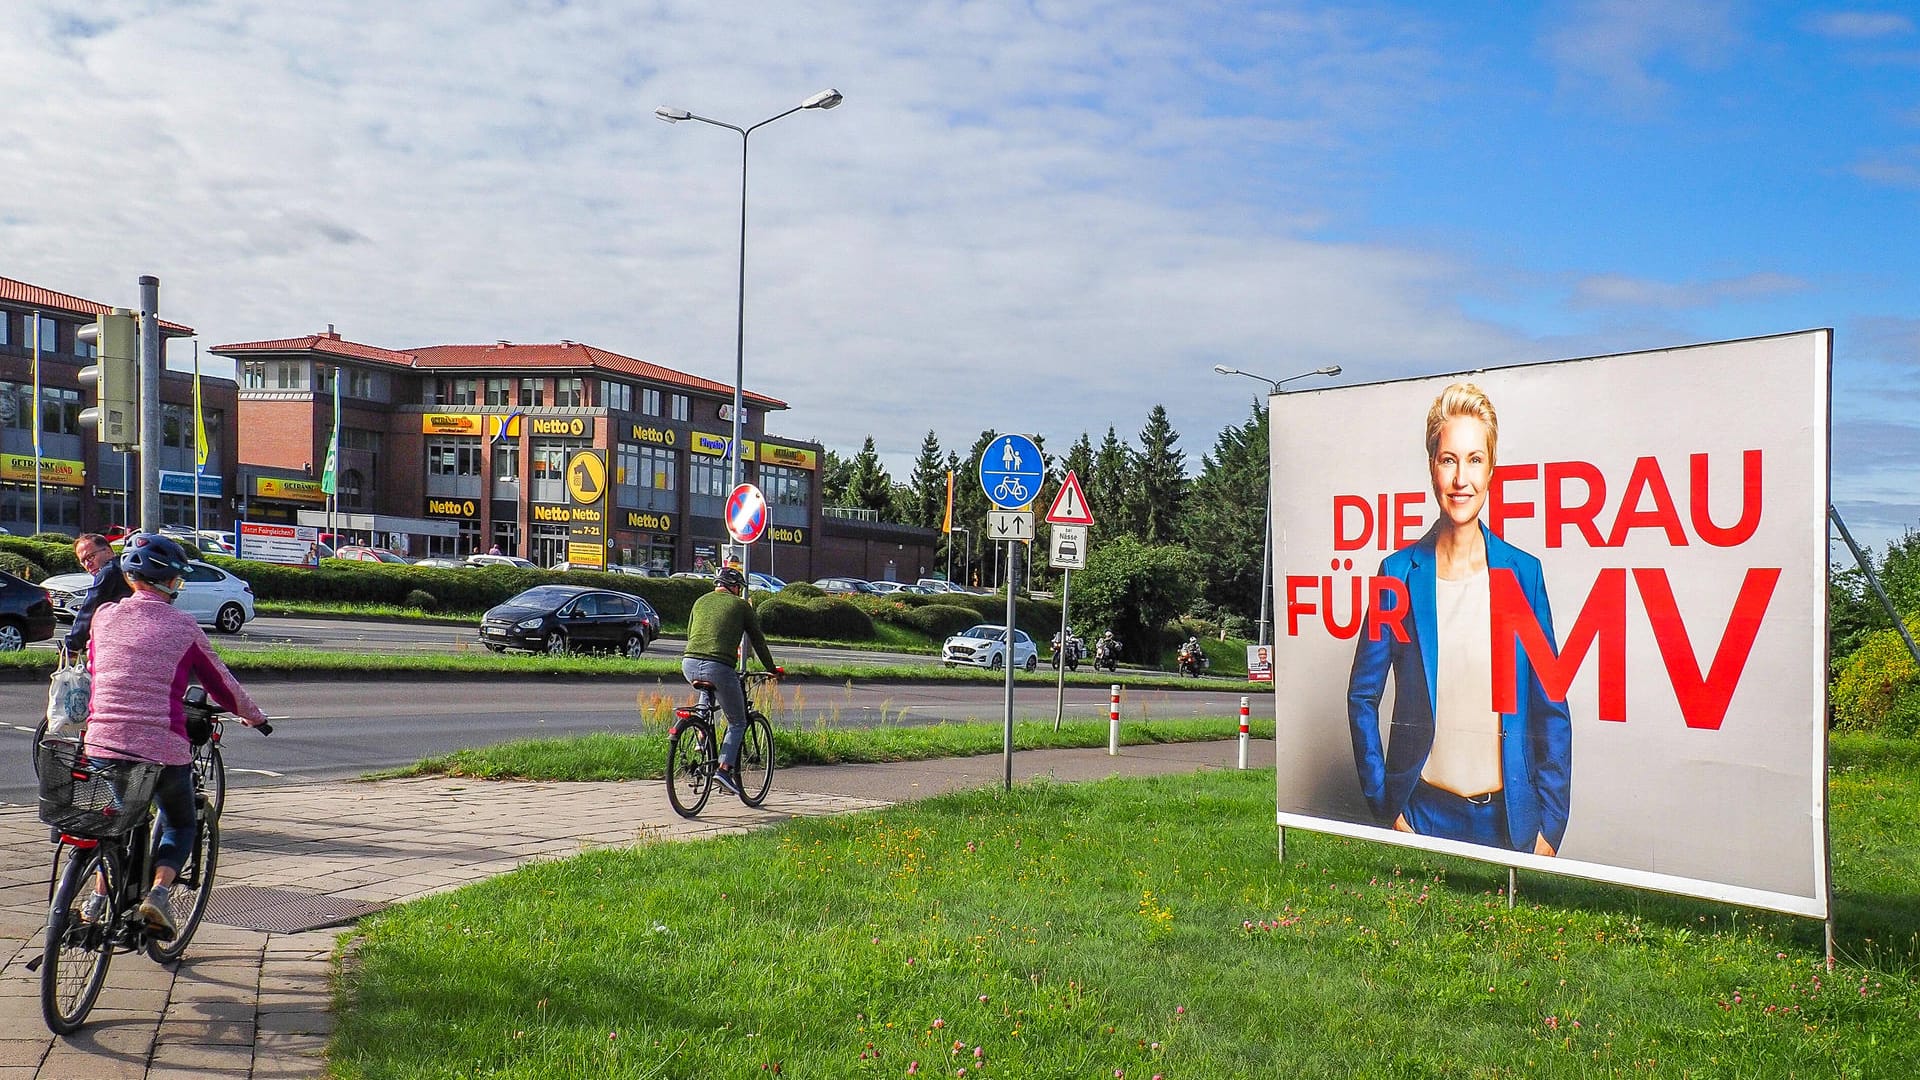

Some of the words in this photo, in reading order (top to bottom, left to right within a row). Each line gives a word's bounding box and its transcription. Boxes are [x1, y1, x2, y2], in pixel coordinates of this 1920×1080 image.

[533, 419, 569, 434] Netto
[633, 425, 663, 443] Netto
[1333, 492, 1426, 551] DIE
[1488, 447, 1763, 549] FRAU
[429, 500, 462, 515] Netto
[534, 506, 570, 521] Netto
[572, 508, 600, 521] Netto
[628, 512, 659, 529] Netto
[1286, 558, 1412, 643] FÜR
[1488, 567, 1782, 731] MV
